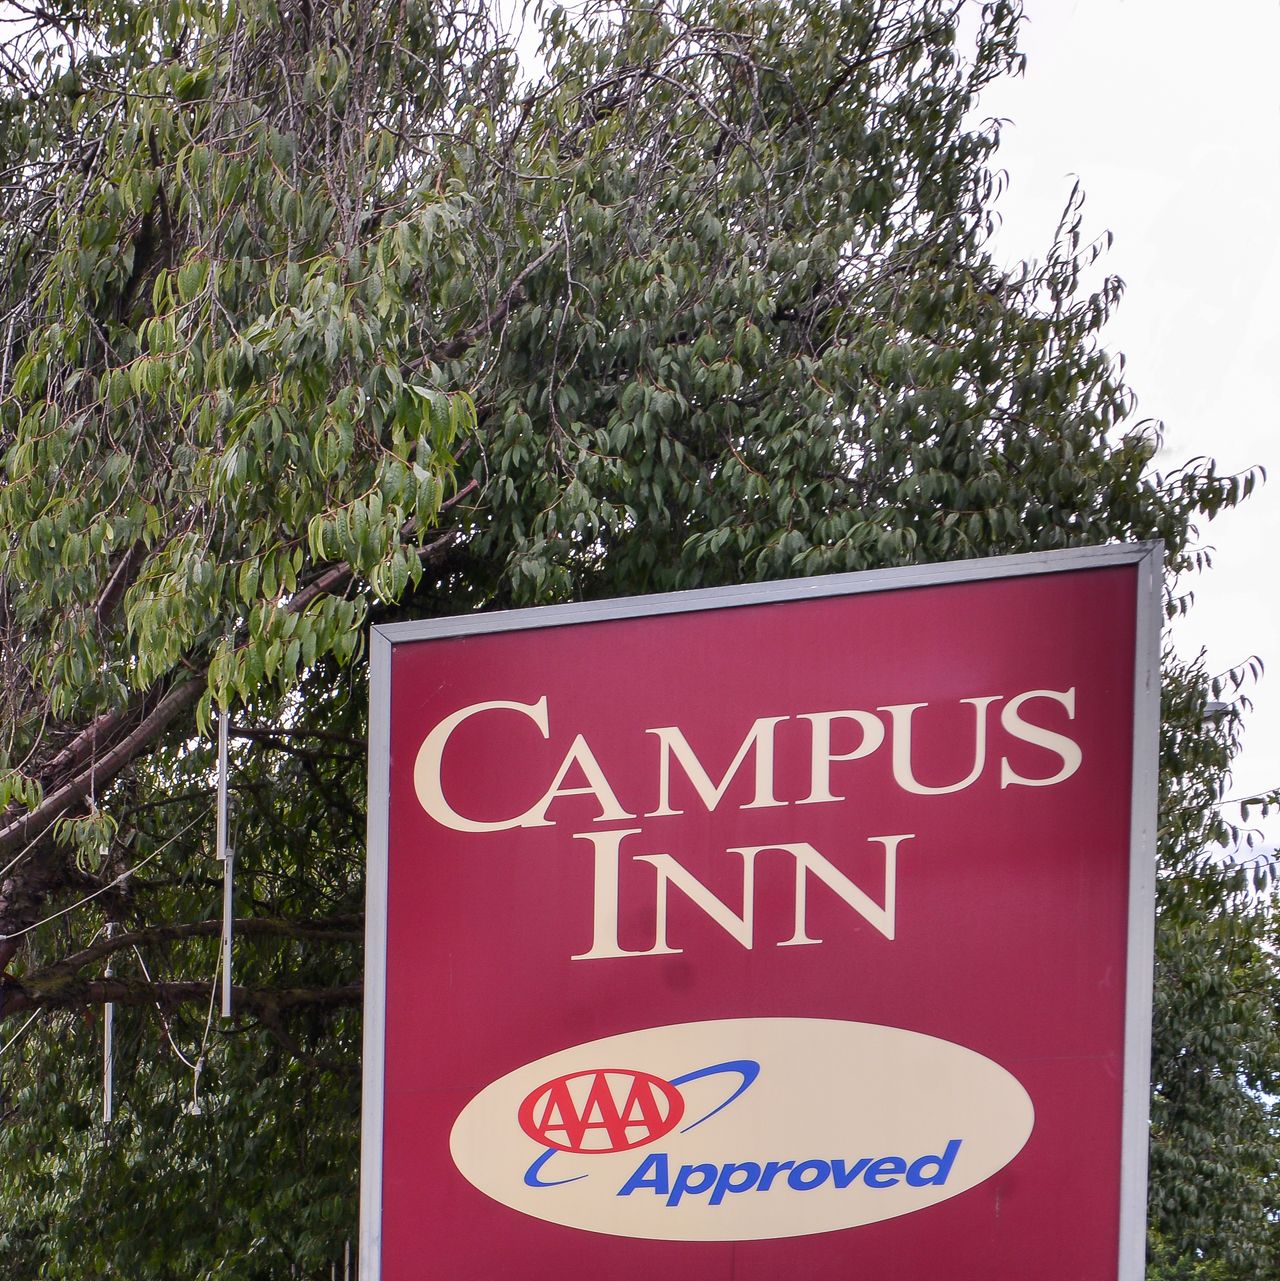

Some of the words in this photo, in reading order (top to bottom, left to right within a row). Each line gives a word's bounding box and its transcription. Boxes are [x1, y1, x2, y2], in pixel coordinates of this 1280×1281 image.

[413, 687, 1083, 833] CAMPUS
[571, 828, 915, 961] INN
[523, 1070, 678, 1153] AAA
[616, 1139, 963, 1207] Approved
